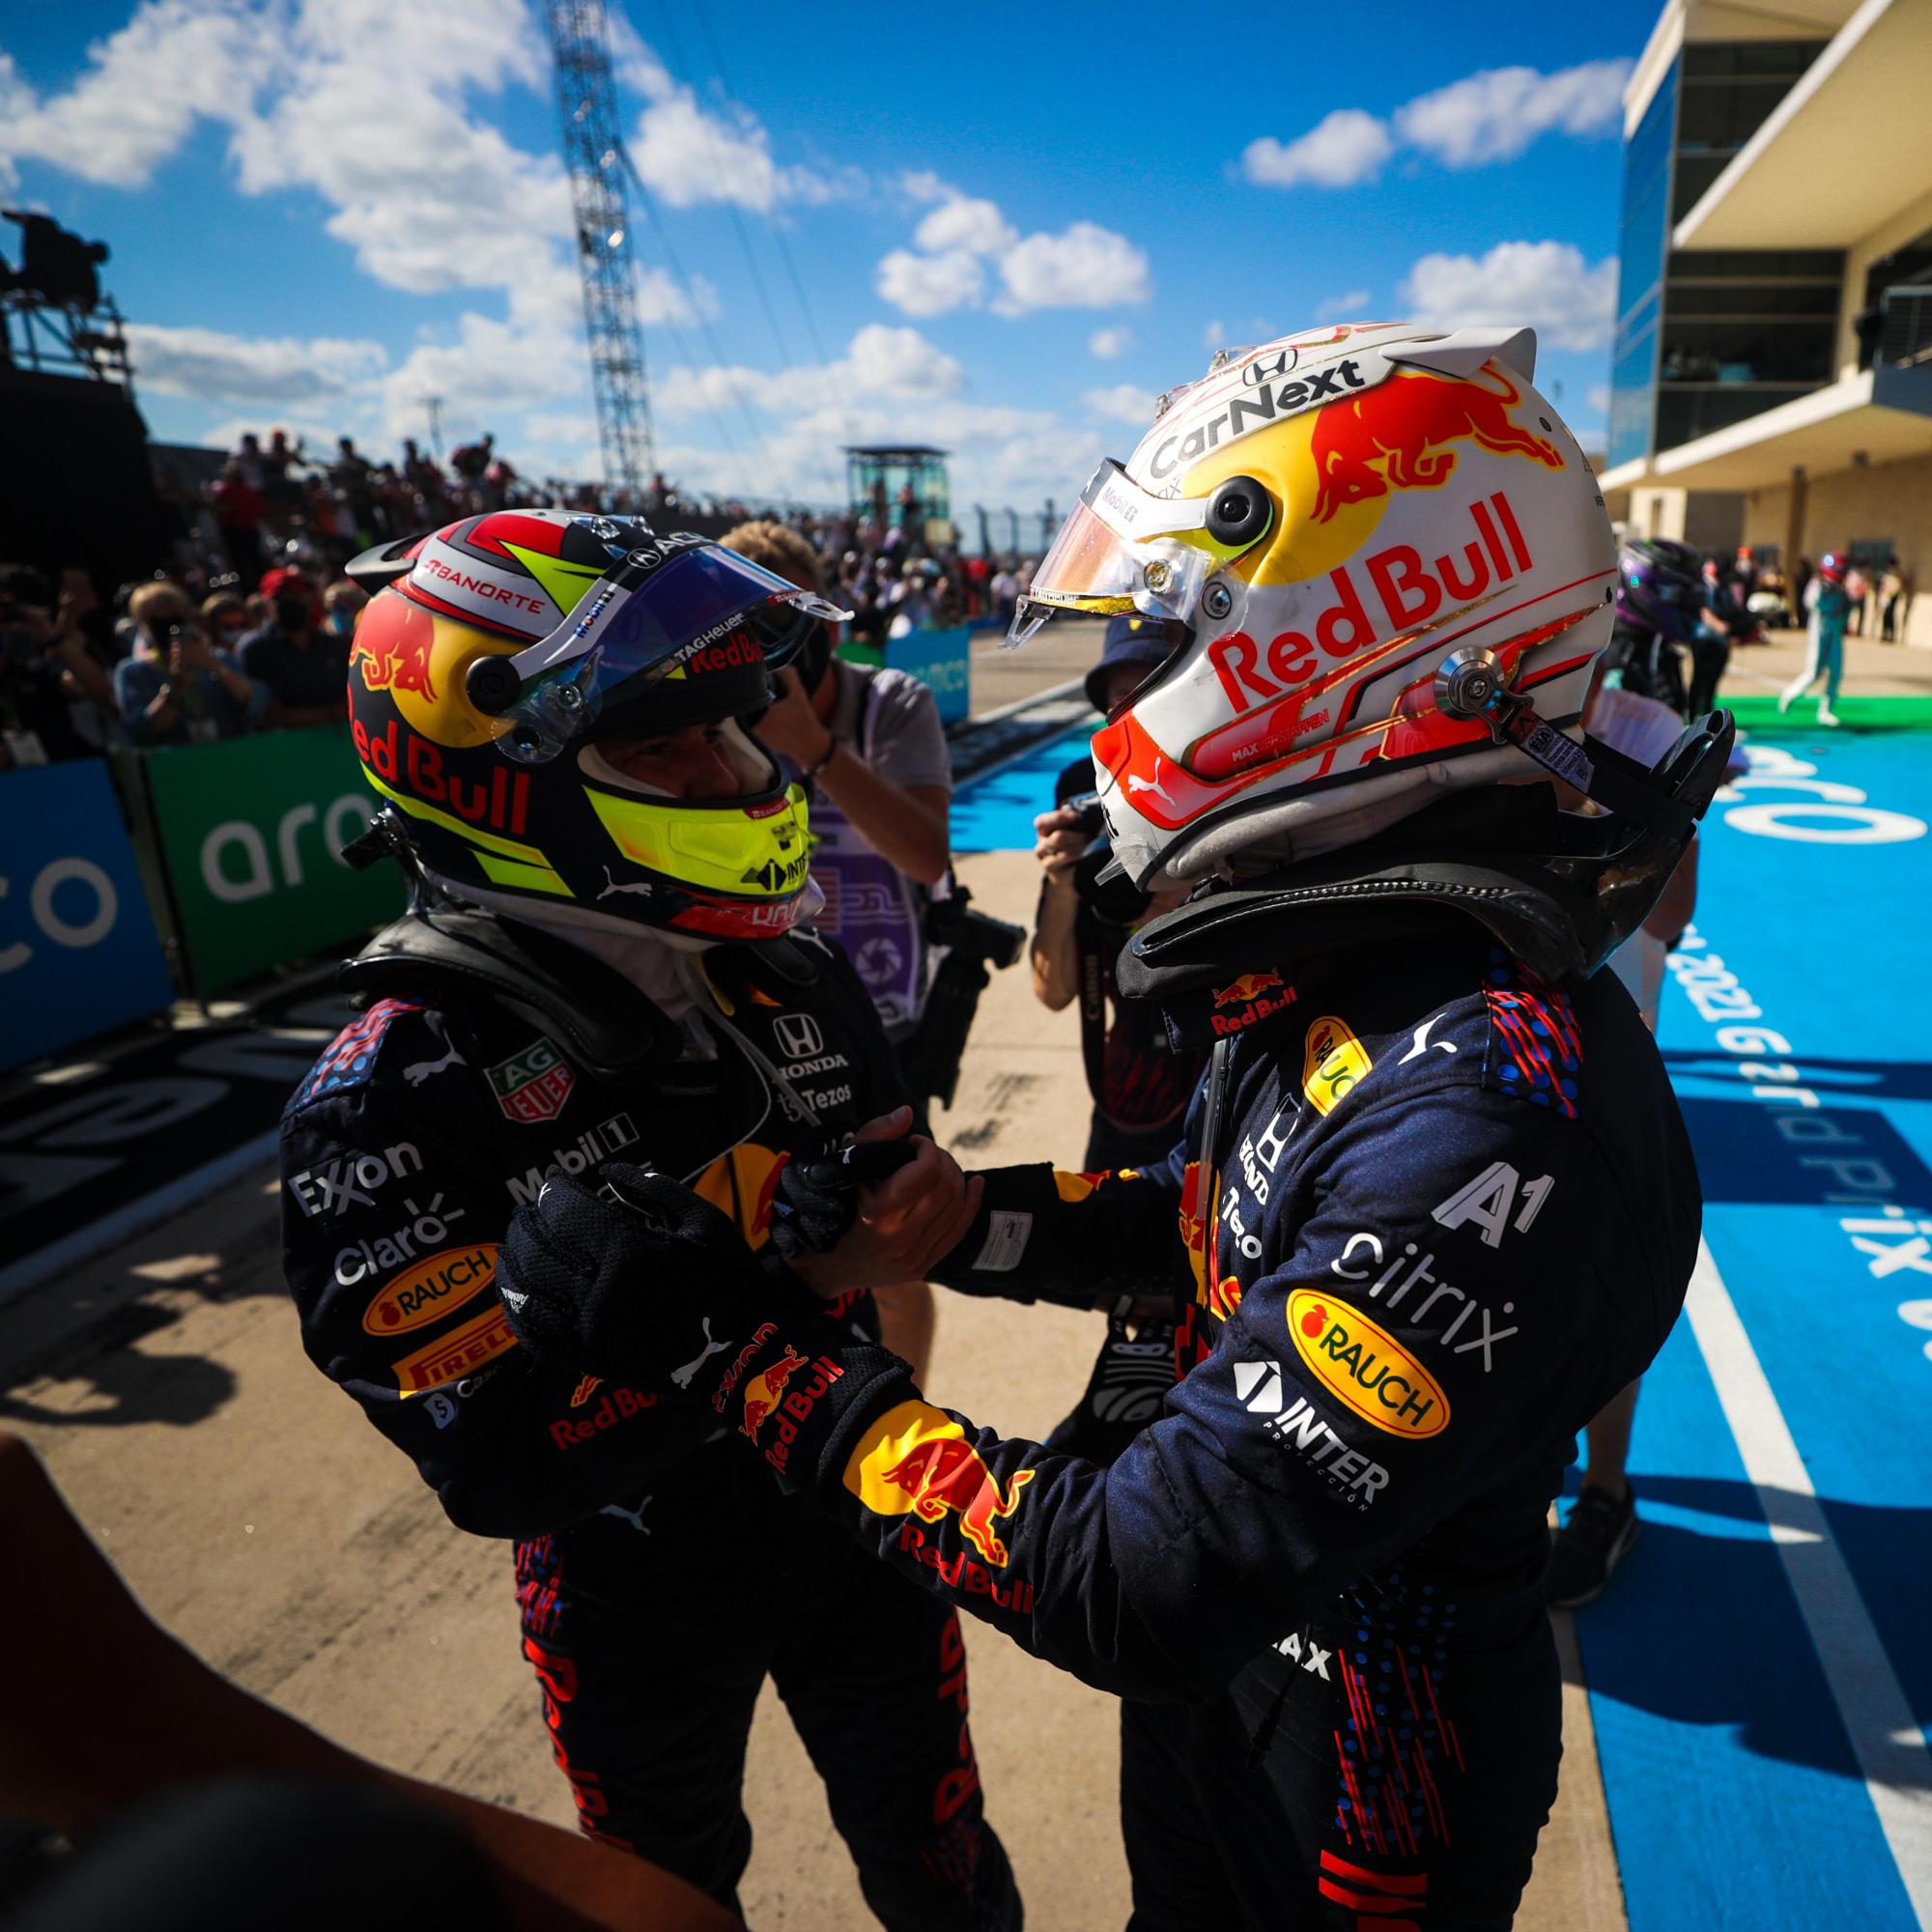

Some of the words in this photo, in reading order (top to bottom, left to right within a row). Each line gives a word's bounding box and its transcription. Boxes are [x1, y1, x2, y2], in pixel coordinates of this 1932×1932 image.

[1151, 359, 1365, 480] CarNext
[1102, 486, 1128, 515] Mobil
[437, 563, 546, 615] BANORTE
[575, 601, 607, 639] Mobil
[1208, 597, 1377, 715] Red
[1366, 491, 1533, 632] Bull
[407, 732, 532, 837] Bull
[1232, 744, 1259, 762] MAX
[1210, 1005, 1259, 1037] Red
[1256, 985, 1299, 1020] Bull
[801, 1084, 851, 1112] Tezos
[1431, 1161, 1554, 1248] A1
[334, 1214, 448, 1287] Claro
[397, 1251, 493, 1316] RAUCH
[1319, 1323, 1435, 1427] RAUCH
[548, 1396, 619, 1451] Red
[763, 1411, 799, 1476] Red
[781, 1354, 845, 1423] Bull
[1274, 1397, 1390, 1504] INTER
[899, 1522, 965, 1587] Red
[965, 1559, 1035, 1615] Bull
[1272, 1633, 1332, 1681] AX
